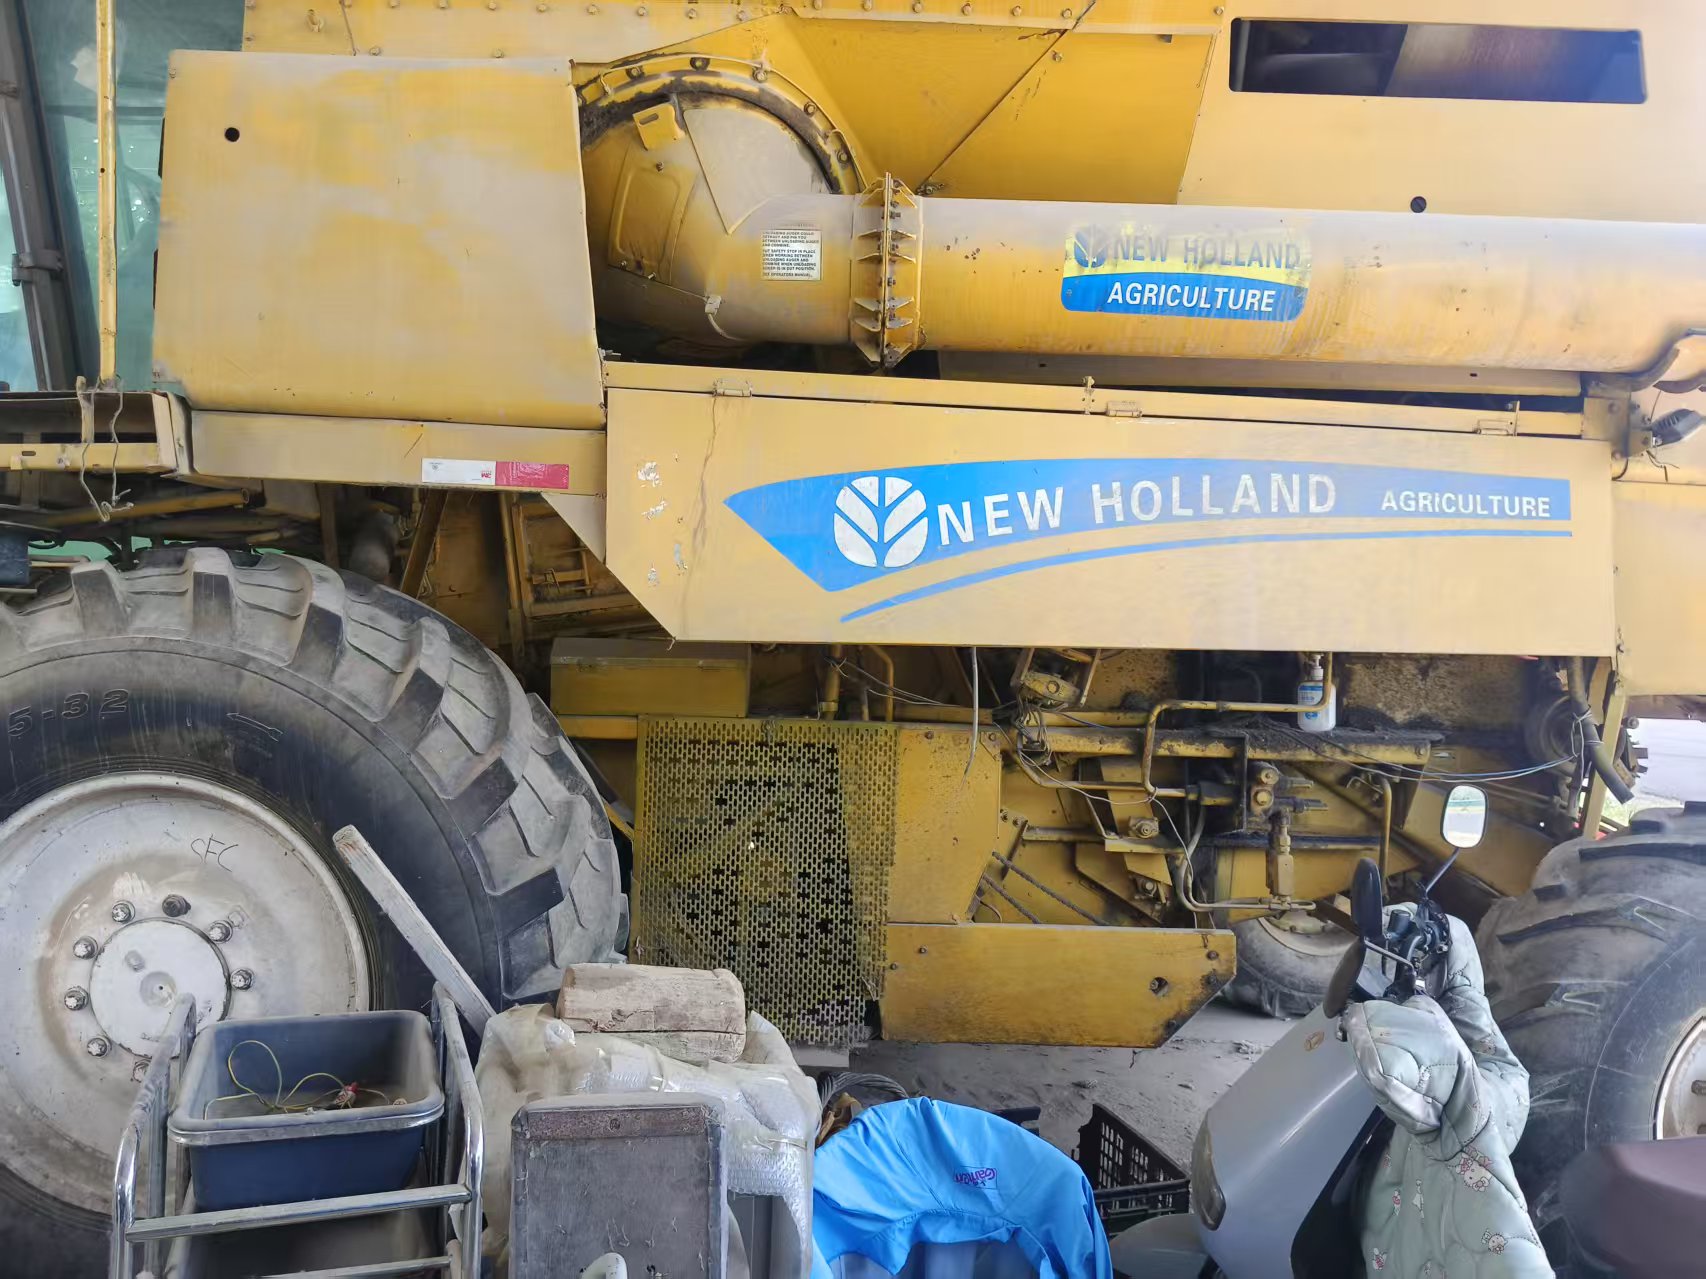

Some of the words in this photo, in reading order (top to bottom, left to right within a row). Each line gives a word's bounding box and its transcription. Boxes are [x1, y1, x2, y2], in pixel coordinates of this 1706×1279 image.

[1113, 233, 1169, 262] NEW
[1183, 236, 1301, 270] HOLLAND
[1107, 282, 1276, 312] AGRICULTURE
[939, 486, 1064, 546] NEW
[1091, 473, 1337, 525] HOLLAND
[1380, 489, 1552, 519] AGRICULTURE
